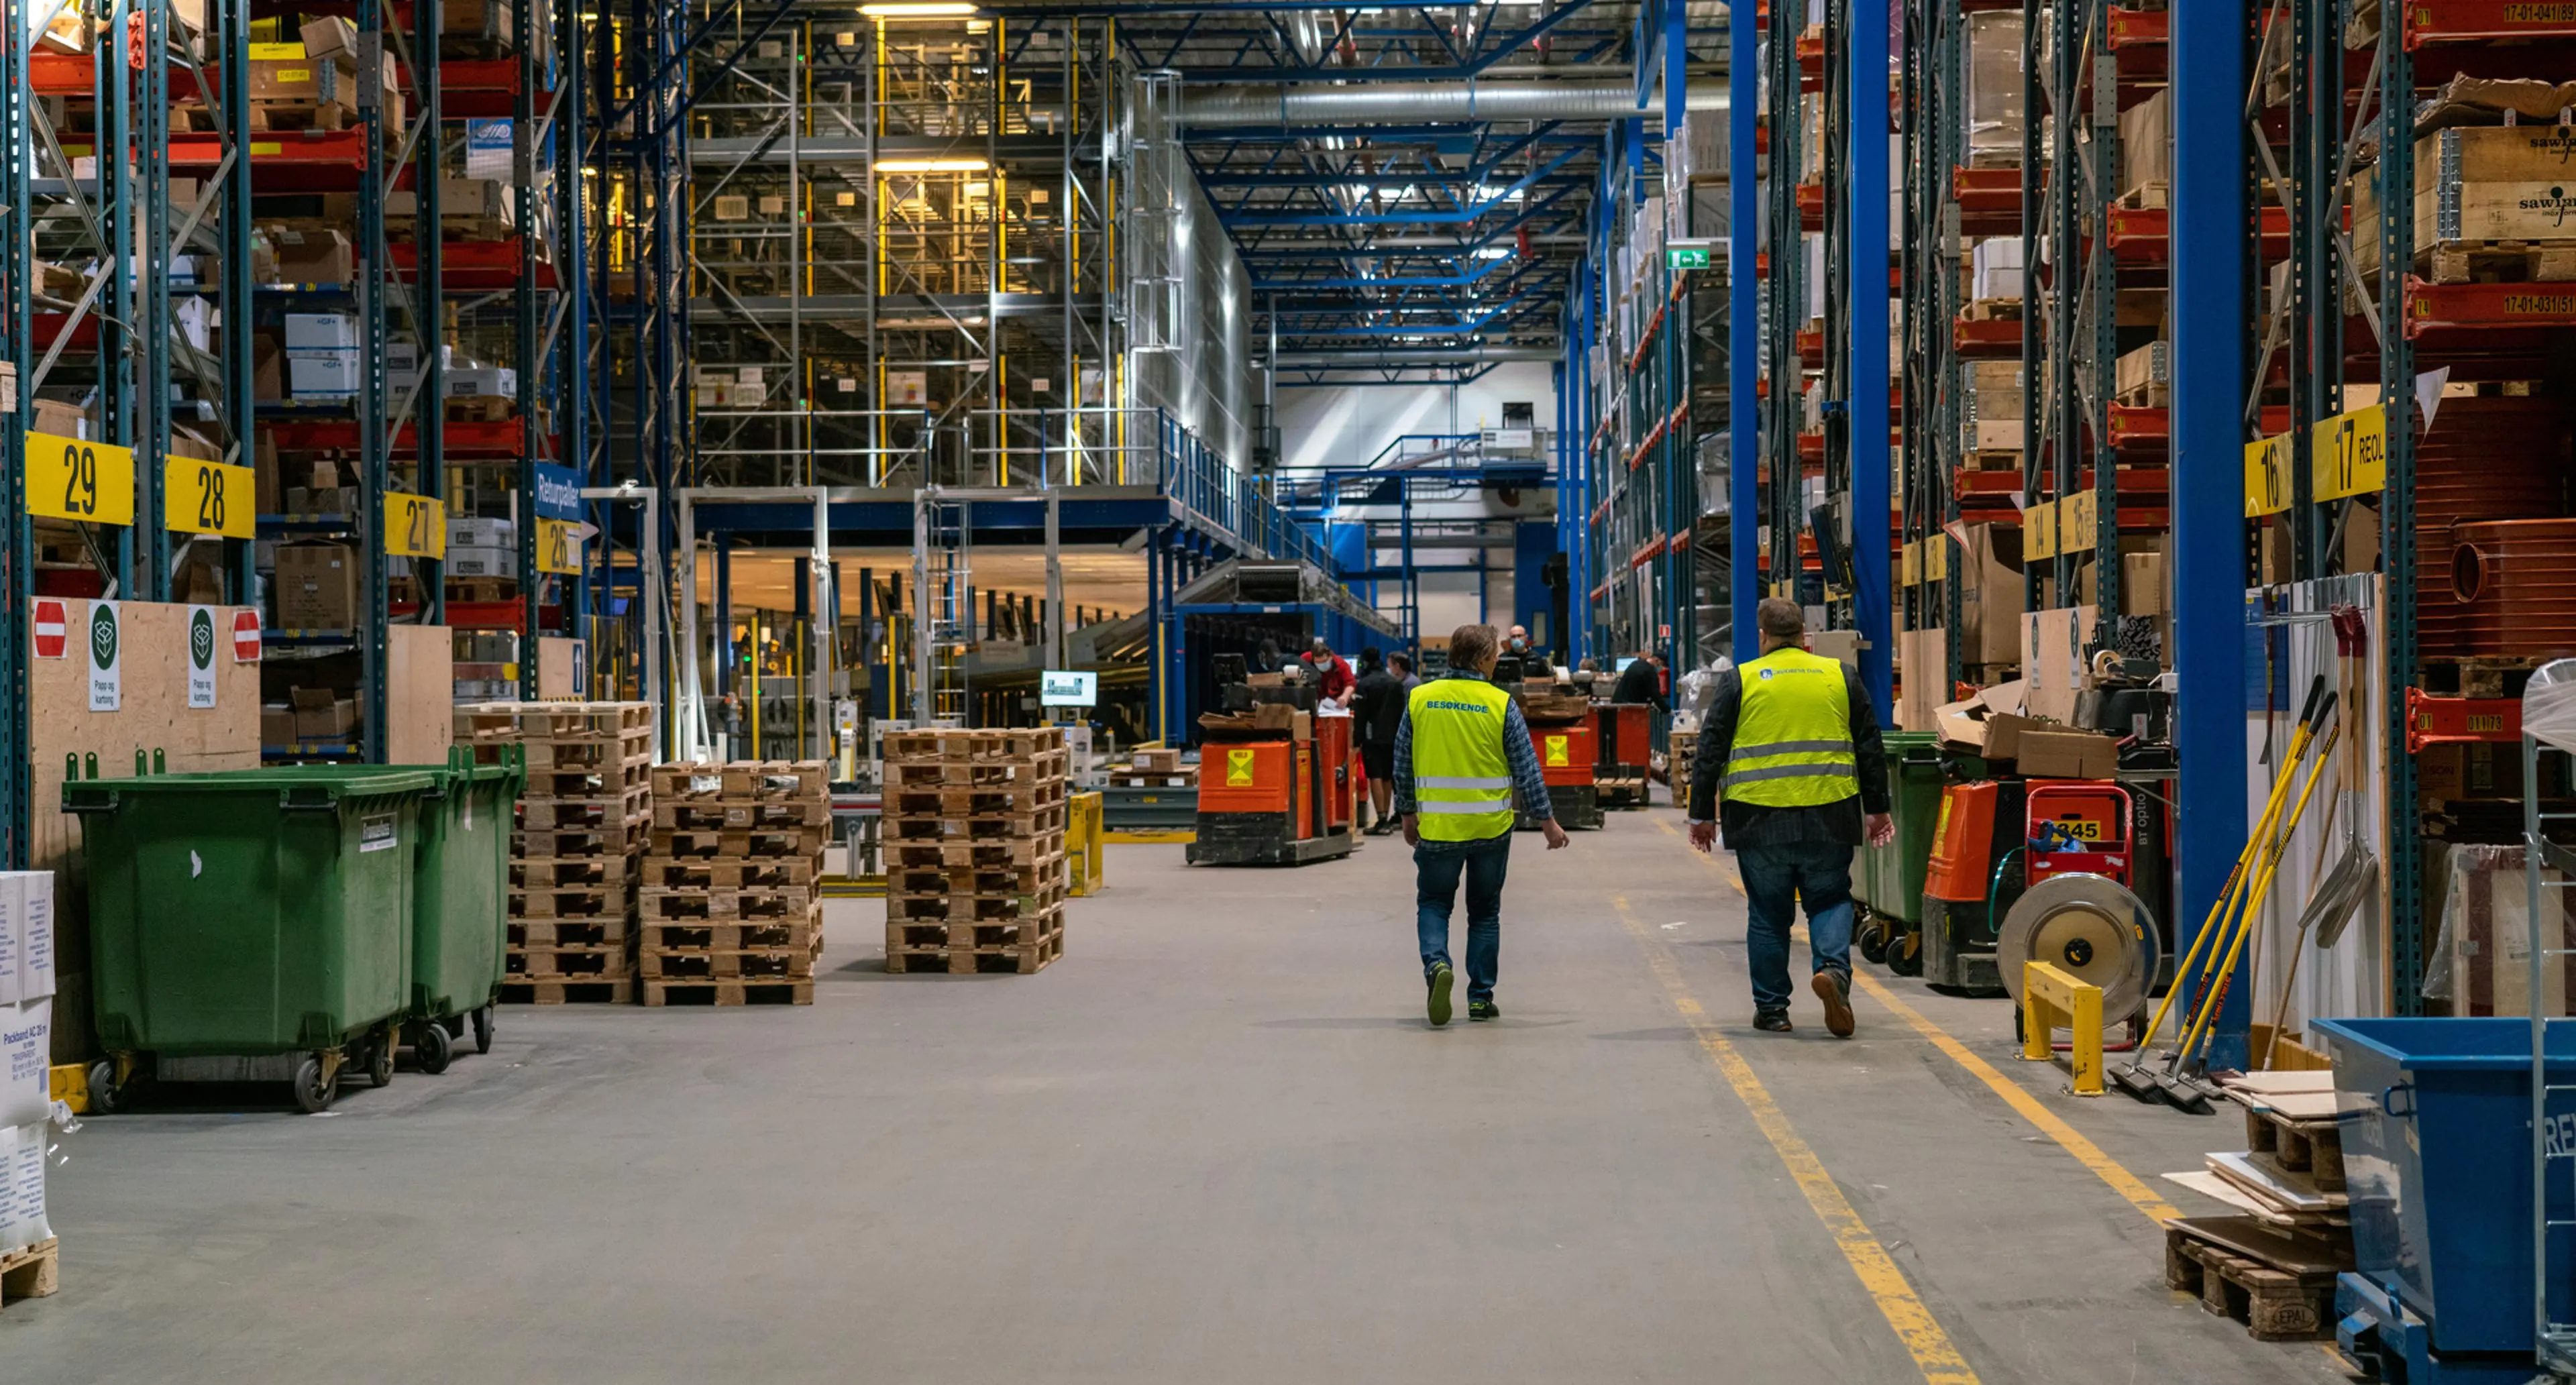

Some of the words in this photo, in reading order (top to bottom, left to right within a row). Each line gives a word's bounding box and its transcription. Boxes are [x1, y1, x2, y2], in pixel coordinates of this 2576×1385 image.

[2417, 9, 2429, 24] 01
[2334, 419, 2355, 491] 17
[2359, 433, 2383, 465] REOL
[64, 444, 97, 516] 29
[2261, 442, 2279, 508] 16
[198, 465, 225, 531] 28
[538, 472, 579, 512] Returpaller
[407, 499, 429, 552] 27
[550, 523, 568, 569] 26
[95, 680, 107, 691] Papp
[108, 681, 115, 693] og
[193, 679, 204, 690] Papp
[205, 680, 211, 691] og
[95, 694, 114, 706] kartong
[194, 693, 211, 704] kartong
[1427, 700, 1489, 714] BESØKENDE
[2419, 714, 2431, 729] 01
[2138, 832, 2148, 845] BT
[2526, 1113, 2576, 1154] RE
[2279, 1308, 2310, 1325] EPAL
